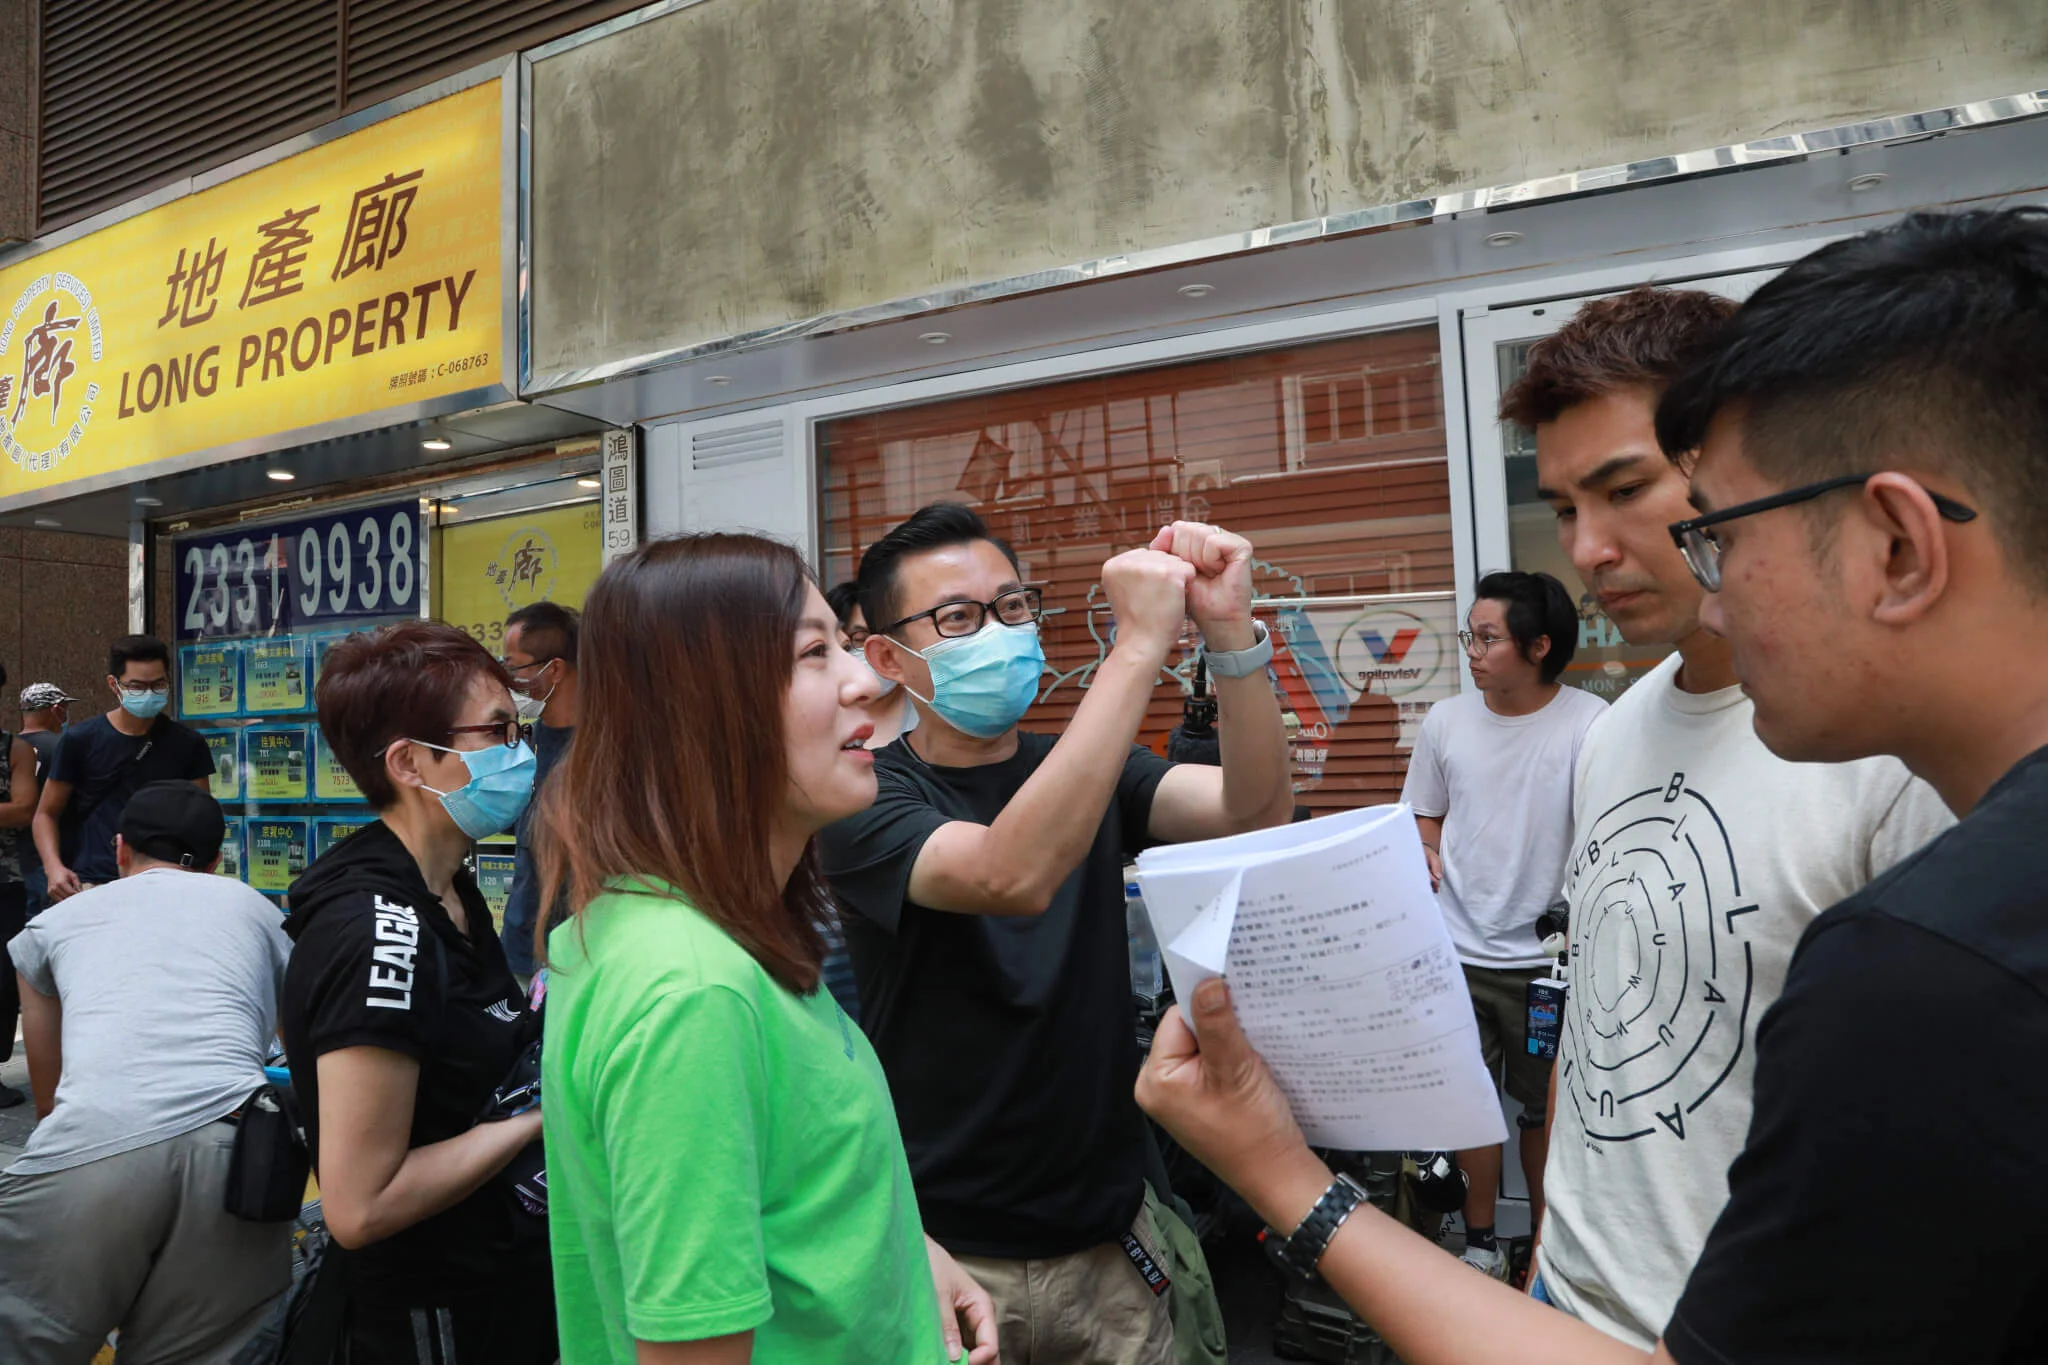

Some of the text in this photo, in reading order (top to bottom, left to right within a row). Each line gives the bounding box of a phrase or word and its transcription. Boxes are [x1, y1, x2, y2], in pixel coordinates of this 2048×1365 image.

[158, 168, 424, 330] 地產廊
[12, 274, 51, 319] PROPERTY
[87, 306, 103, 362] LIMITED
[118, 269, 477, 419] LONG PROPERTY
[608, 434, 631, 561] 鴻圖道59
[185, 533, 279, 630] 2331
[300, 512, 414, 617] 9938
